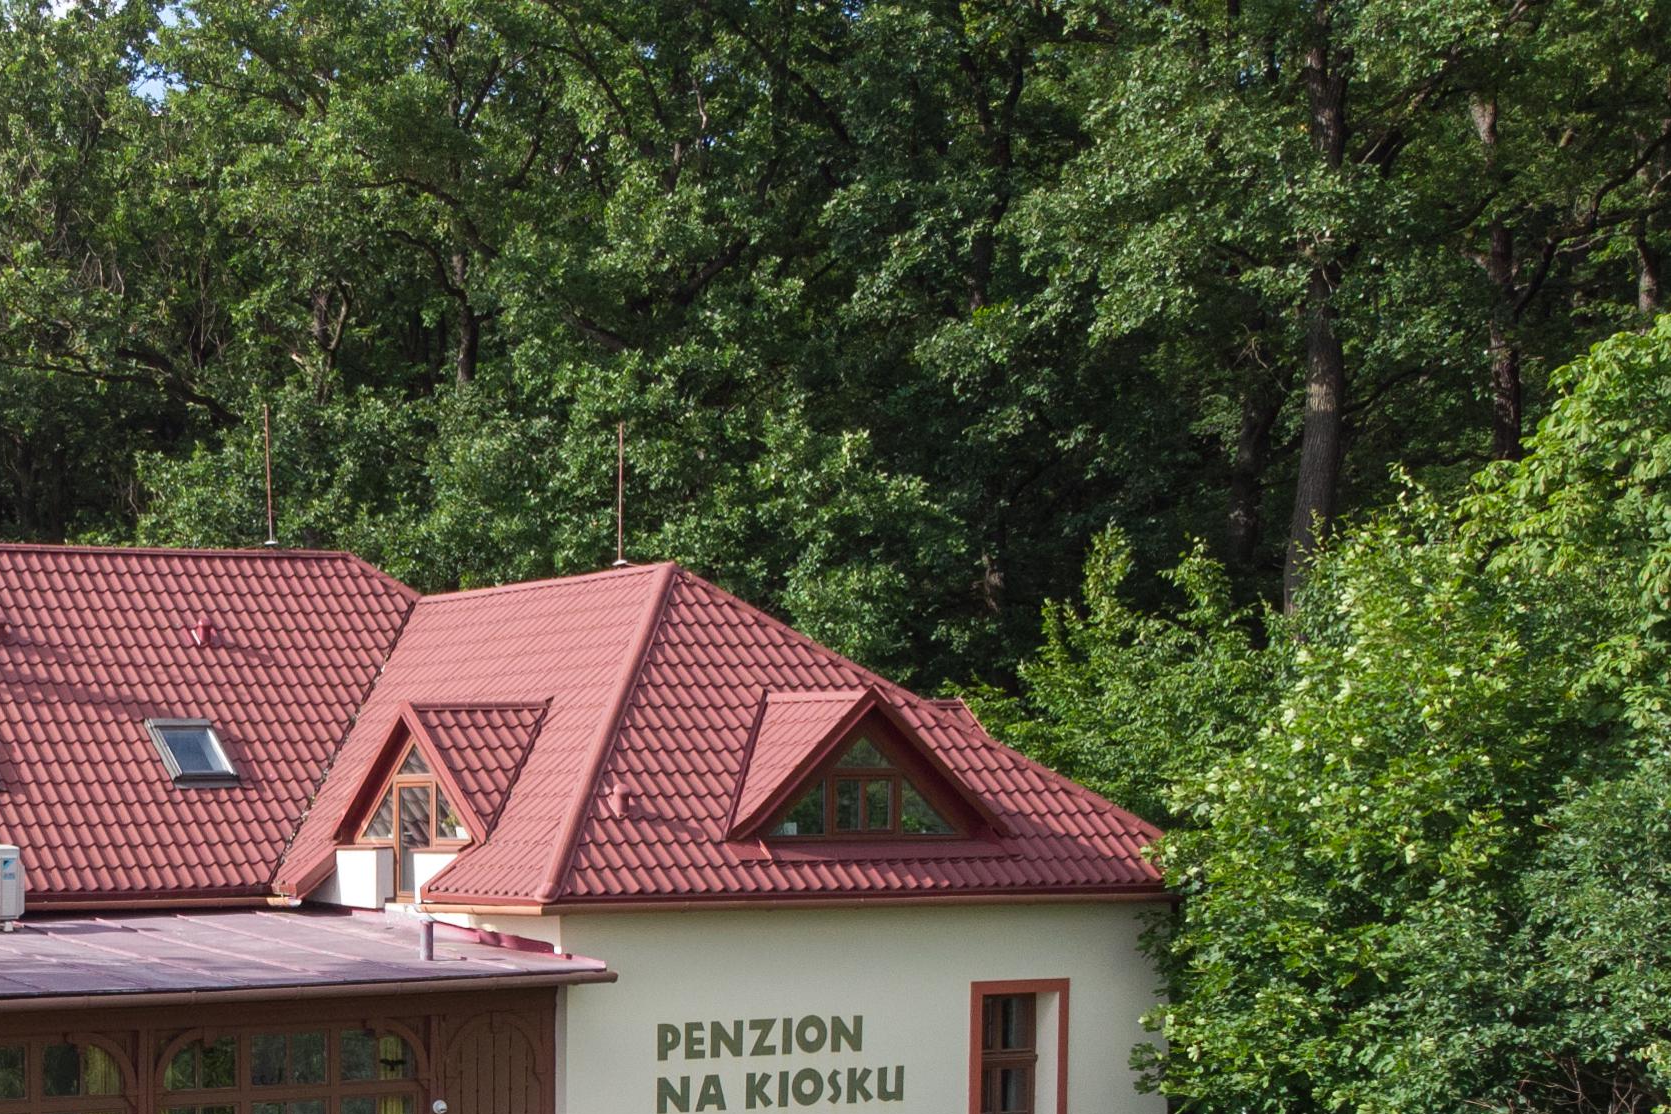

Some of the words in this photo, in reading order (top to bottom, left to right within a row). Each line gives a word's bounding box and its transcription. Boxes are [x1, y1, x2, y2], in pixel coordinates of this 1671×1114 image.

[657, 1014, 864, 1061] PENZION
[656, 1074, 727, 1114] NA
[745, 1065, 905, 1110] KIOSKU
